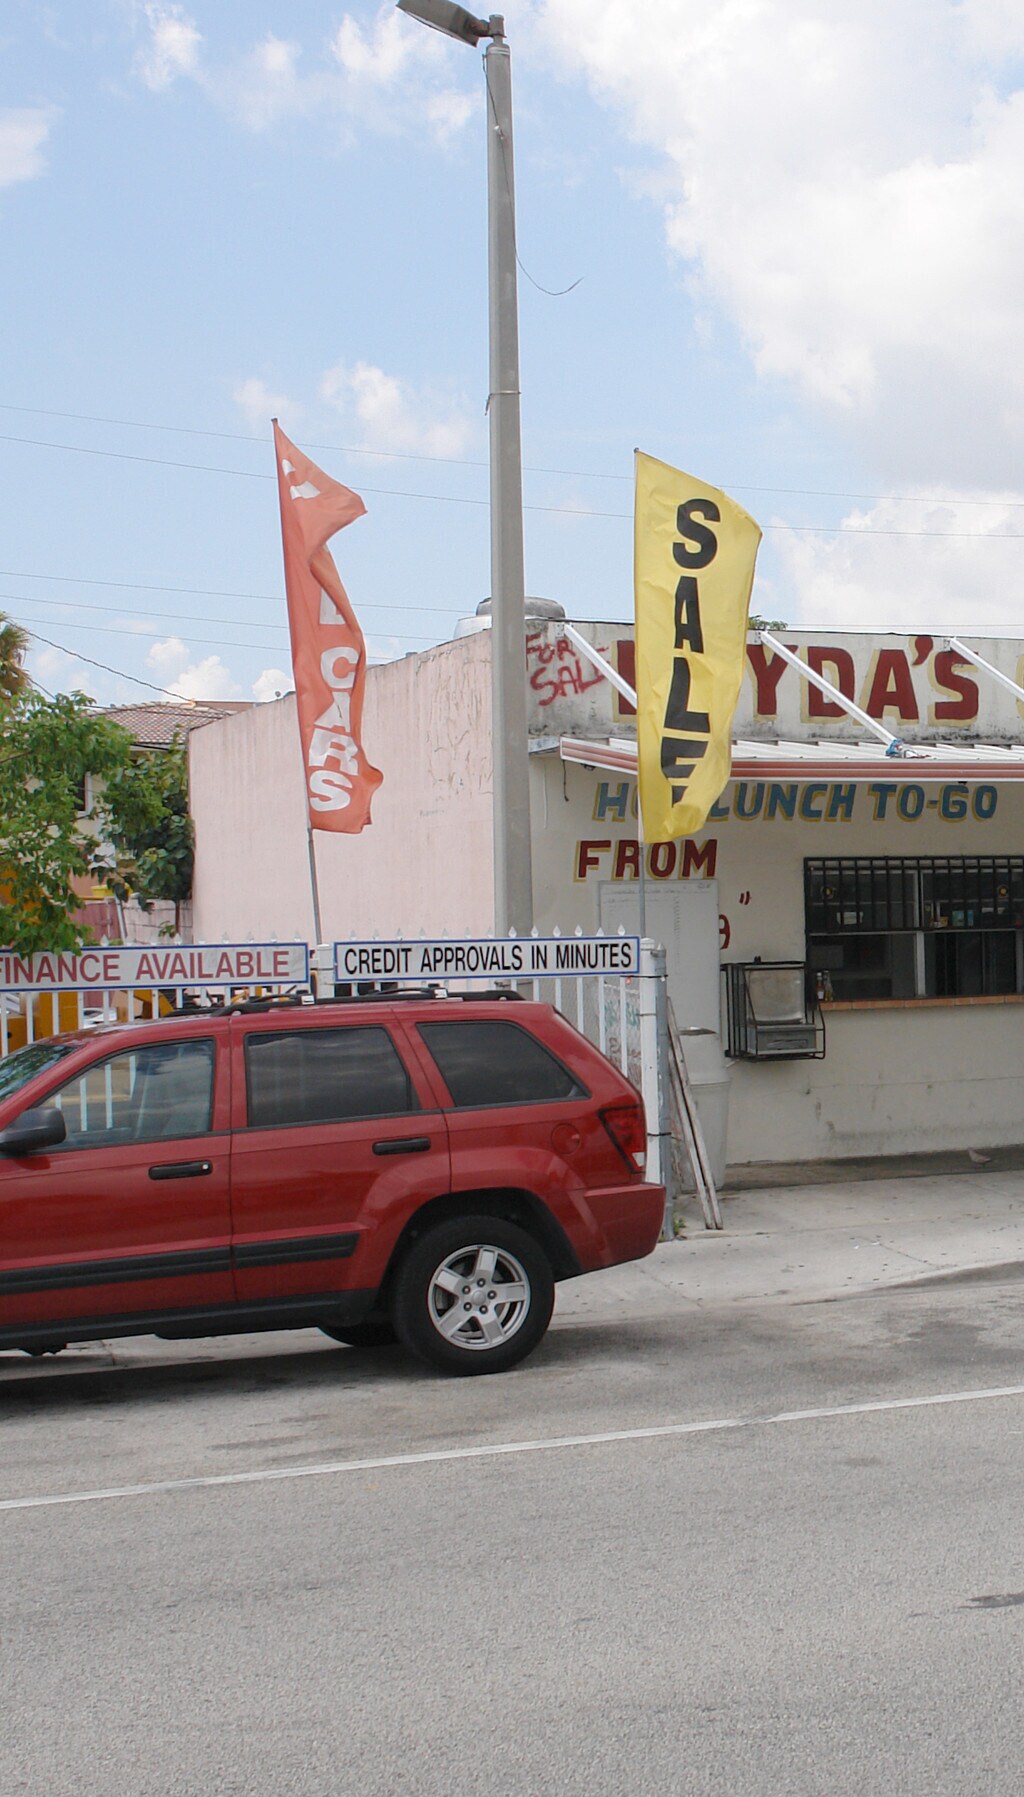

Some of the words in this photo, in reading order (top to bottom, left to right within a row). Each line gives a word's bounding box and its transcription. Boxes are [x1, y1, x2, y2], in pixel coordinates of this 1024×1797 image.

[661, 498, 721, 808] SALE
[308, 646, 361, 812] CARS
[574, 839, 719, 883] FROM
[136, 950, 290, 980] AVAILABLE
[344, 947, 412, 975] CREDIT
[420, 944, 523, 973] APPROVALS
[530, 944, 548, 970] IN
[555, 942, 632, 970] MINUTES
